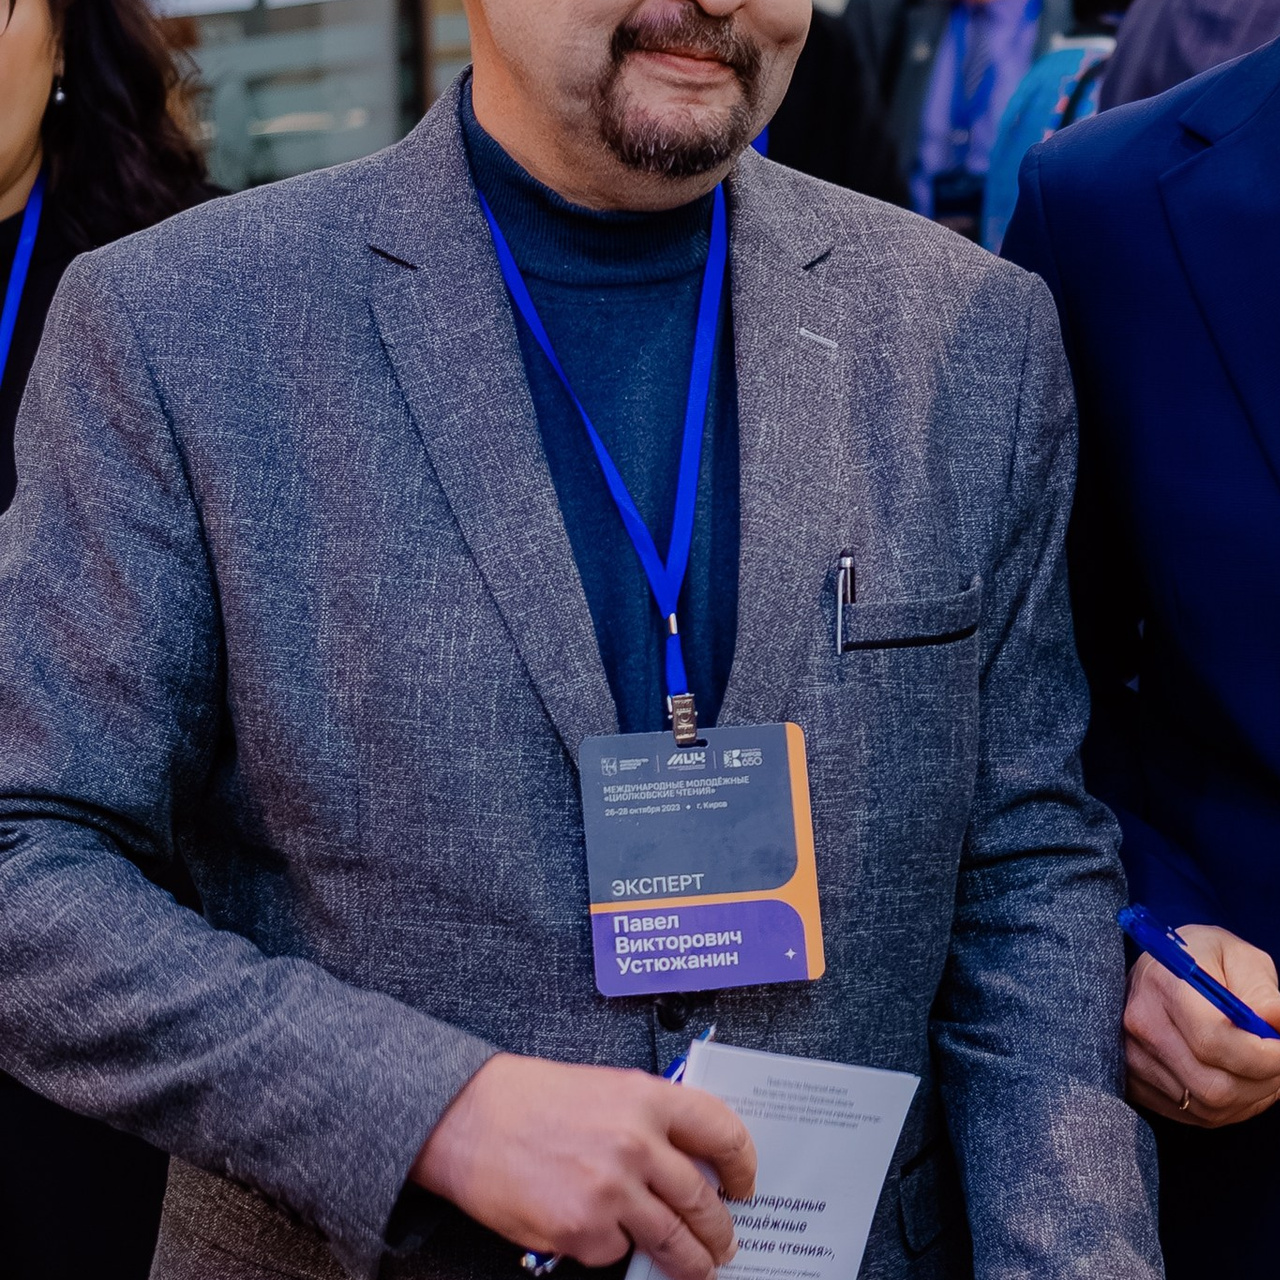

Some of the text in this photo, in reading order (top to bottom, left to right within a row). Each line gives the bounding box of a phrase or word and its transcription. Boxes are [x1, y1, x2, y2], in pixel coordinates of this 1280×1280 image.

[603, 775, 750, 794] МЕЖДУНАРОДНЫЕ МОЛОДЁЖНЫЕ
[661, 803, 681, 812] 2023
[611, 873, 705, 897] ЭКСПЕРТ
[613, 915, 679, 934] Павел
[615, 930, 742, 954] Викторович
[616, 951, 739, 975] Устюжанин
[732, 1214, 808, 1234] олодёжные
